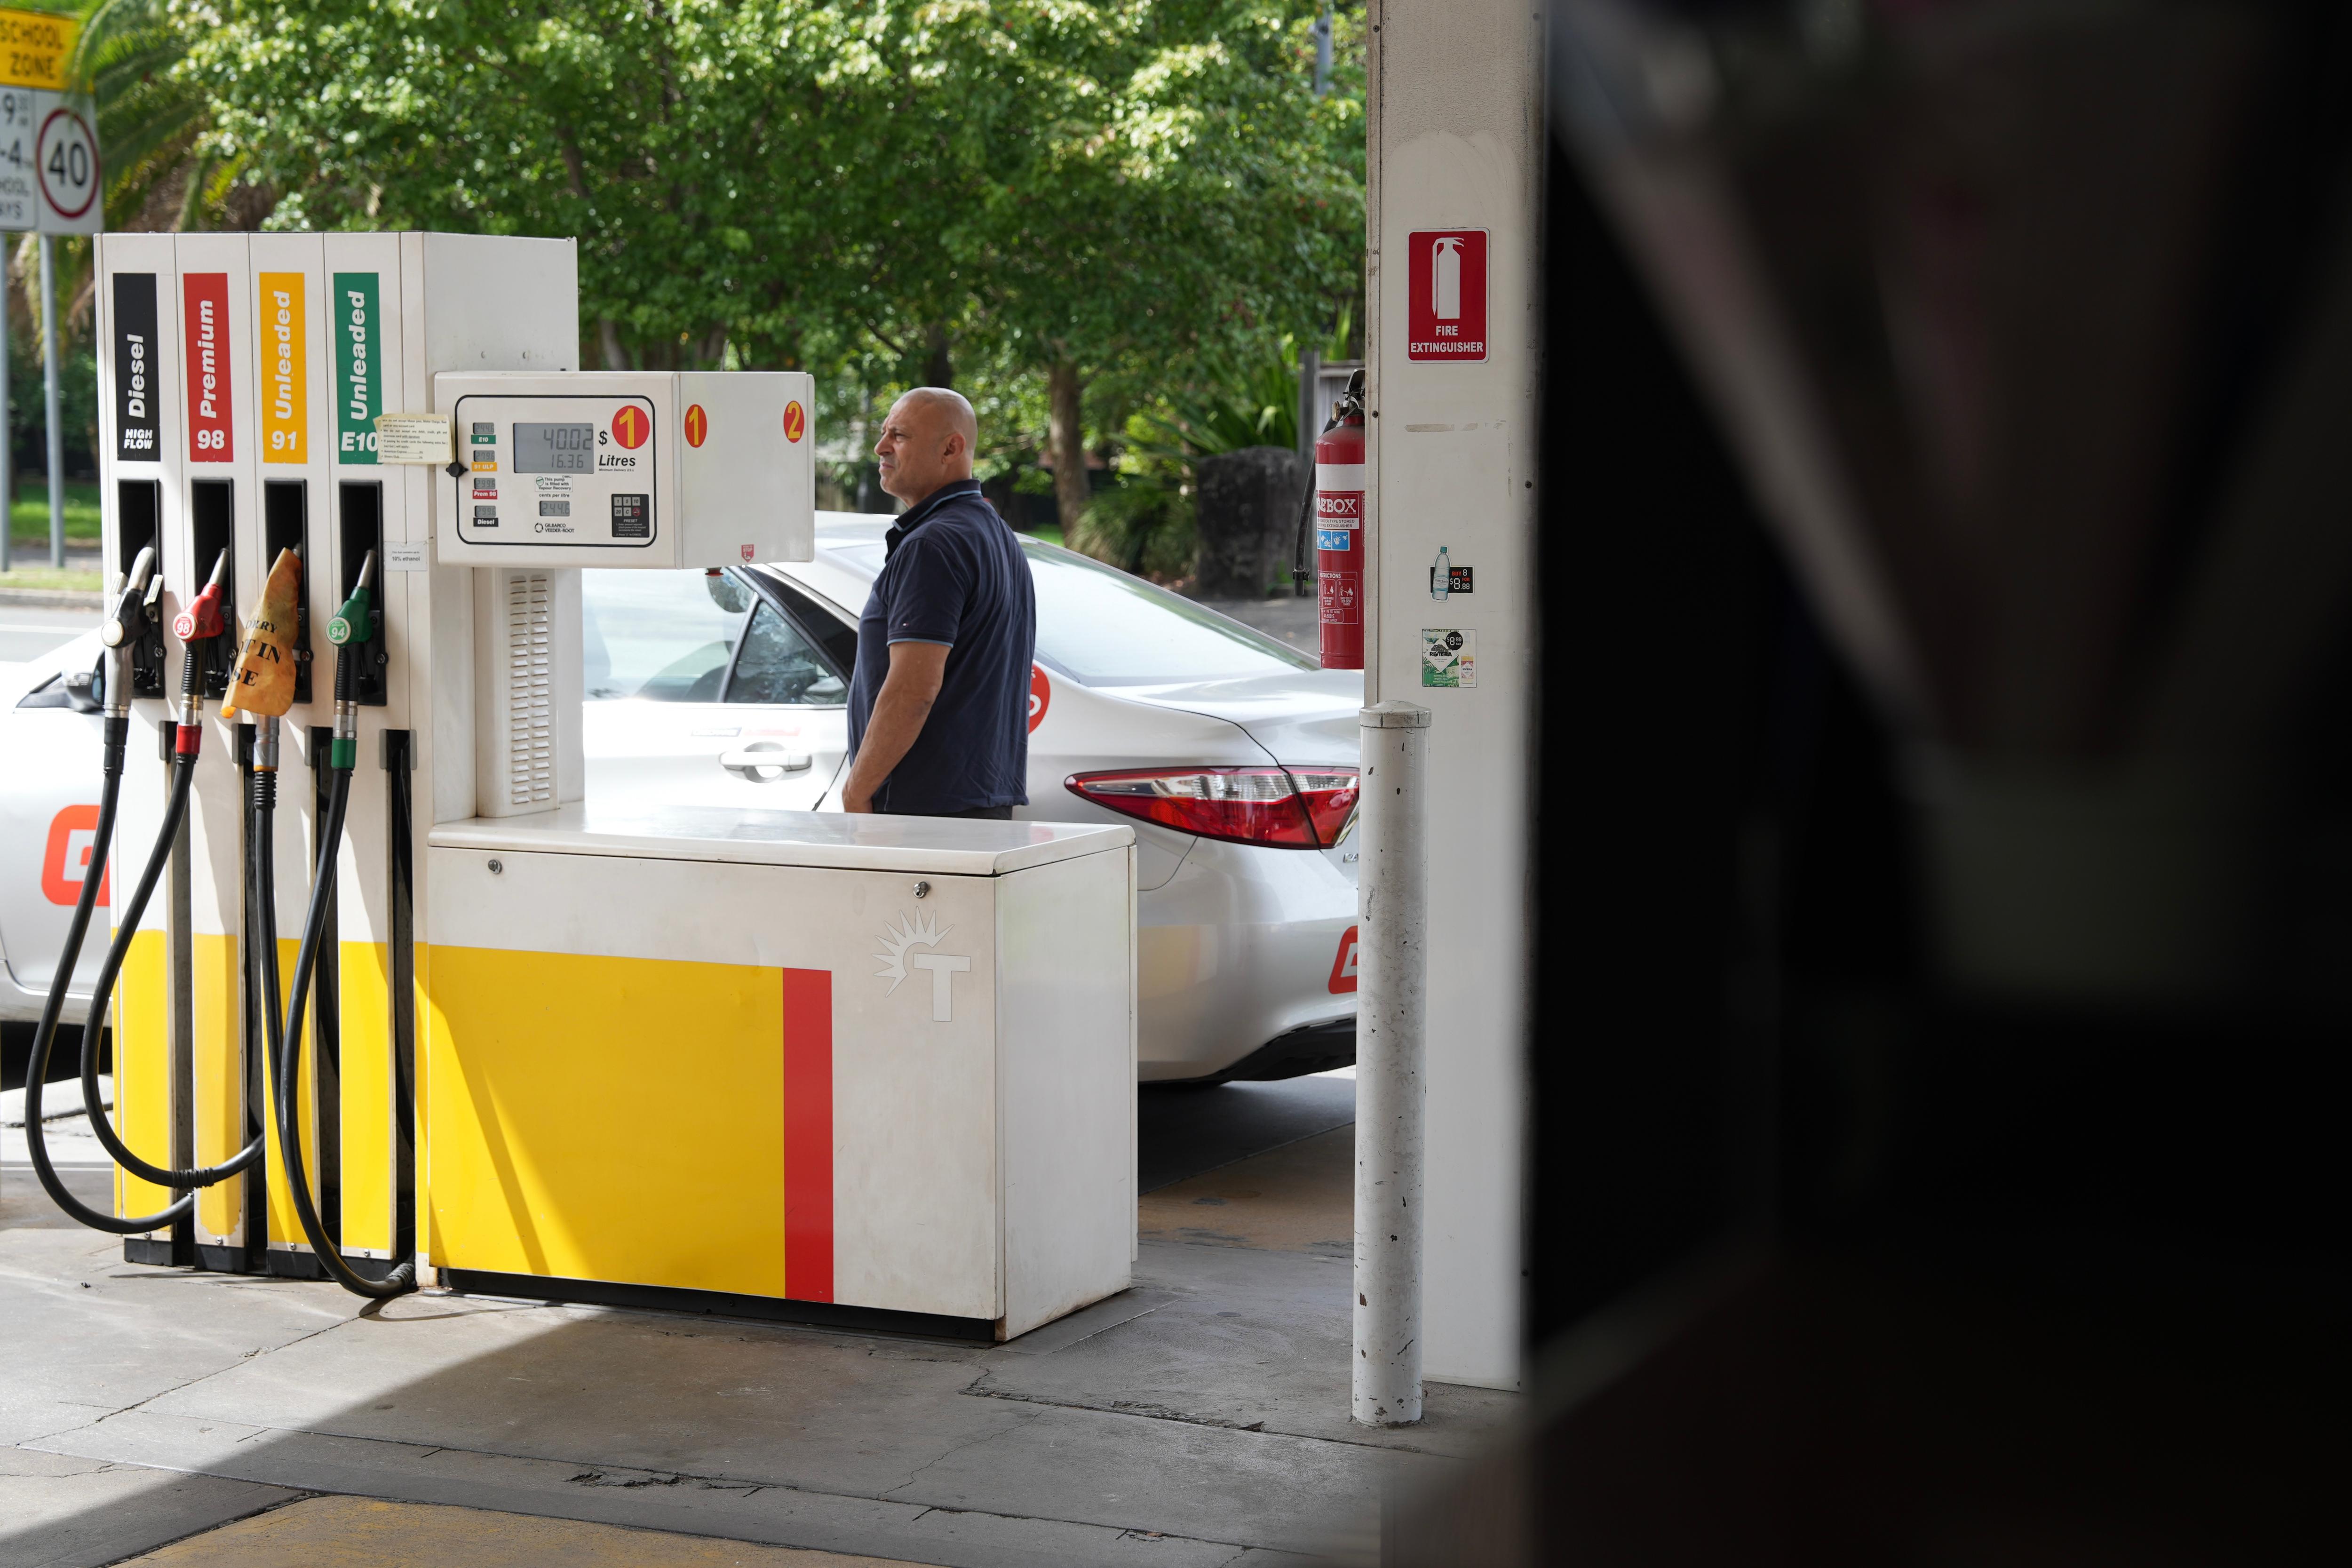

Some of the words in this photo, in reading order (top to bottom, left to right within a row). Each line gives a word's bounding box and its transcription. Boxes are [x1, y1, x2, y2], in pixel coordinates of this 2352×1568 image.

[10, 52, 56, 80] ZONE
[49, 140, 87, 187] 40
[1436, 325, 1458, 336] FIRE
[273, 291, 292, 420] Unleaded
[348, 291, 368, 420] Unleaded
[1411, 342, 1483, 352] EXTINGUISHER
[198, 300, 217, 418] Premium
[127, 334, 145, 418] Diesel
[619, 408, 635, 447] 1
[689, 406, 699, 446] 1
[787, 401, 801, 439] 2
[124, 439, 152, 449] FLOW
[125, 429, 152, 439] HIGH
[198, 429, 225, 449] 98
[271, 430, 297, 450] 91
[341, 431, 378, 452] E10
[543, 429, 593, 450] 40.02
[598, 430, 608, 446] $
[551, 454, 583, 468] 16.36
[599, 454, 636, 467] Litres
[542, 502, 570, 514] 244.6
[177, 622, 190, 634] 98
[332, 627, 345, 638] 94
[256, 642, 281, 664] IN
